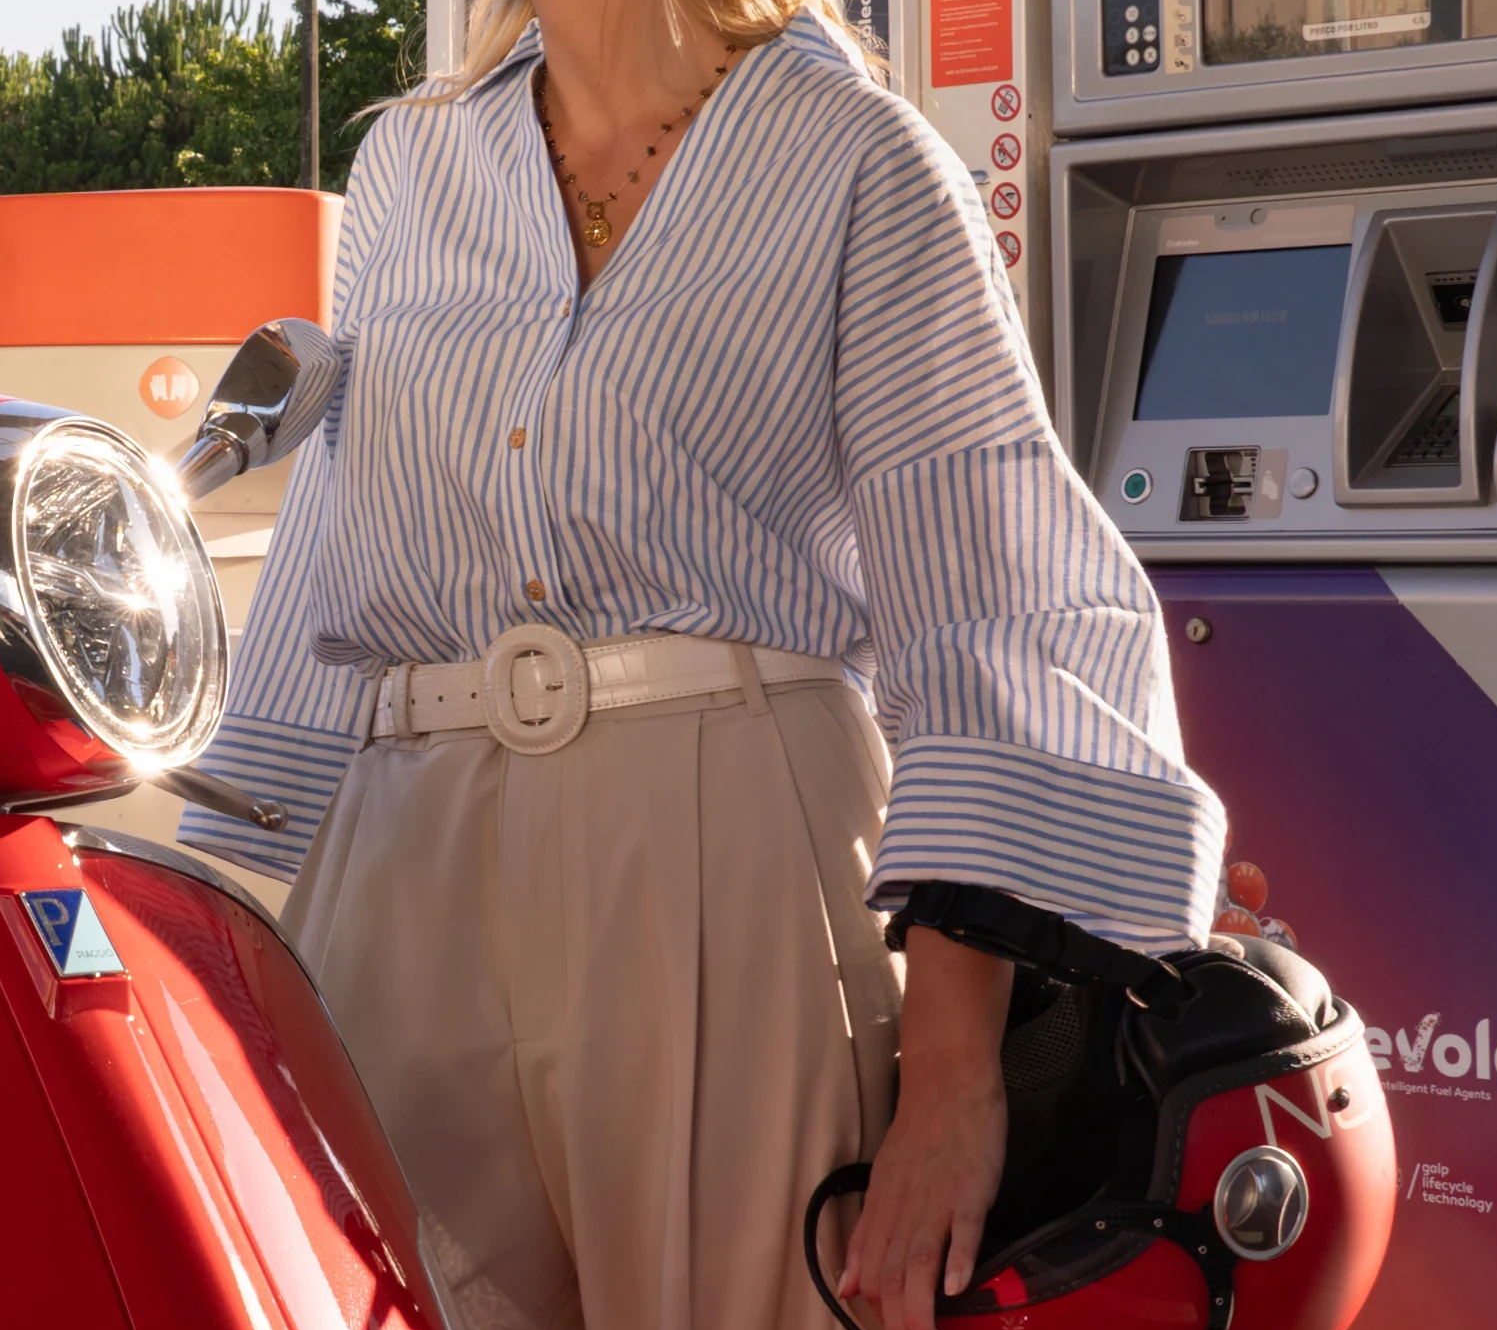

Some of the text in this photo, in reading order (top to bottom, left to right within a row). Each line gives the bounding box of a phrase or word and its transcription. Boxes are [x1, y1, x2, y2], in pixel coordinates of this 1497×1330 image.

[1310, 24, 1335, 36] PREÇO
[1337, 23, 1353, 32] POR
[1355, 20, 1378, 31] LITRO
[31, 898, 69, 946] P
[76, 949, 114, 960] PIAGGIO
[1429, 1084, 1452, 1096] Fuel
[1454, 1087, 1492, 1101] Agents
[1421, 1162, 1449, 1177] galp
[1421, 1176, 1474, 1195] lifecycle
[1421, 1190, 1493, 1214] technology
